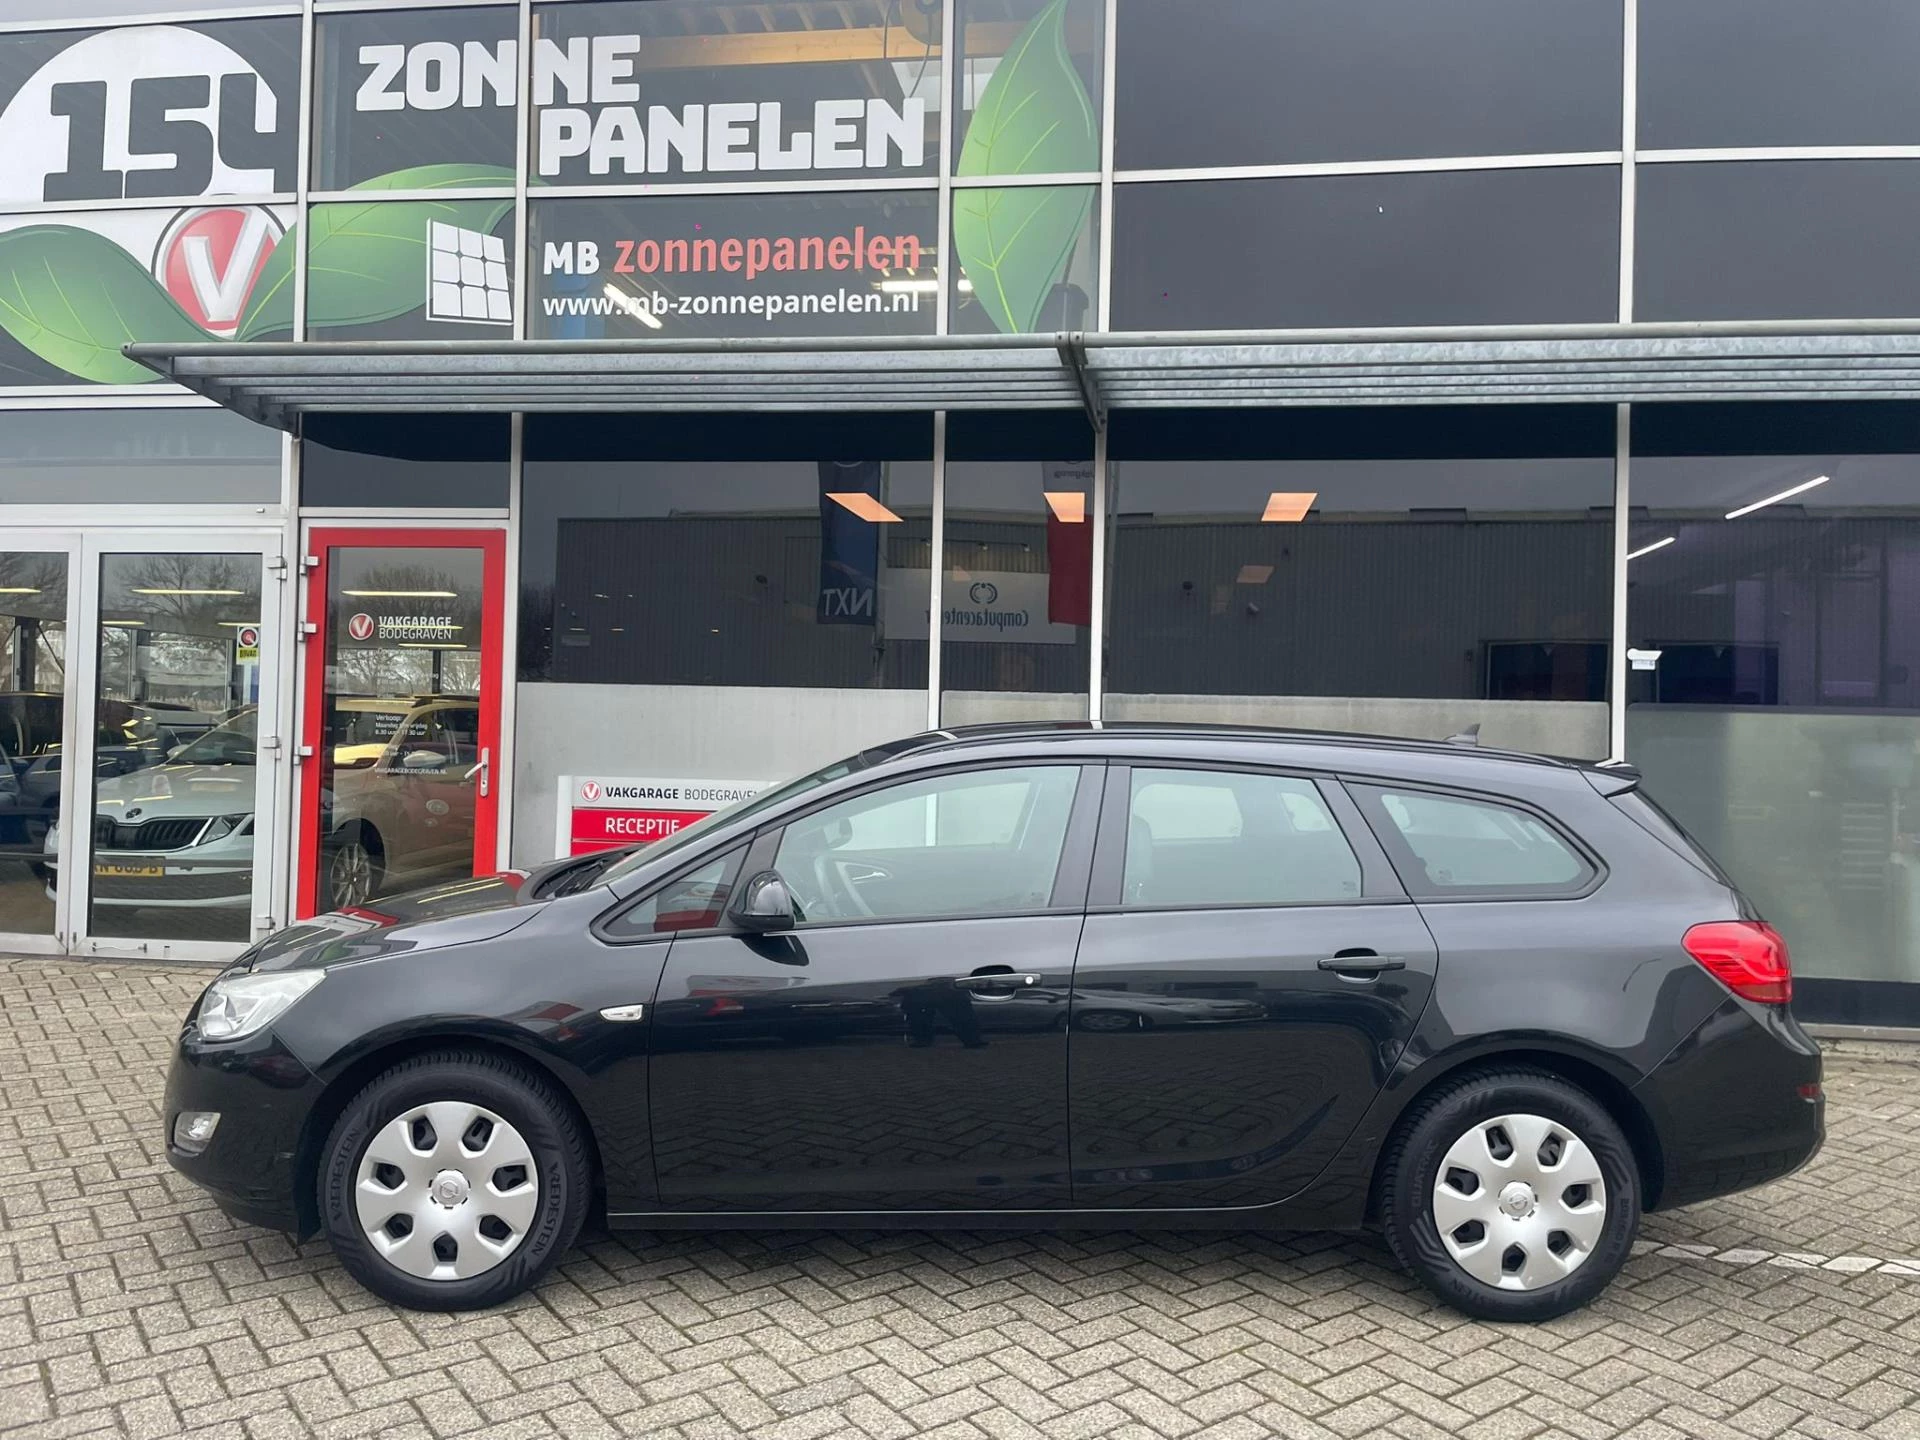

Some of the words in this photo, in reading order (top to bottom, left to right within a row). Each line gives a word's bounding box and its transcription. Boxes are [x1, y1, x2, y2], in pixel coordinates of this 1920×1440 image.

[356, 35, 641, 112] ZONNE
[539, 97, 925, 176] PANELEN
[543, 241, 600, 276] MB
[614, 226, 921, 280] zonnepanelen
[543, 287, 920, 321] www.mb-zonnepanelen.nl
[378, 616, 452, 628] VAKGARAGE
[379, 627, 452, 640] BODEGRAVEN
[606, 786, 679, 800] VAKGARAGE
[684, 788, 758, 801] BODEGRAVE
[605, 817, 681, 835] RECEPTIE
